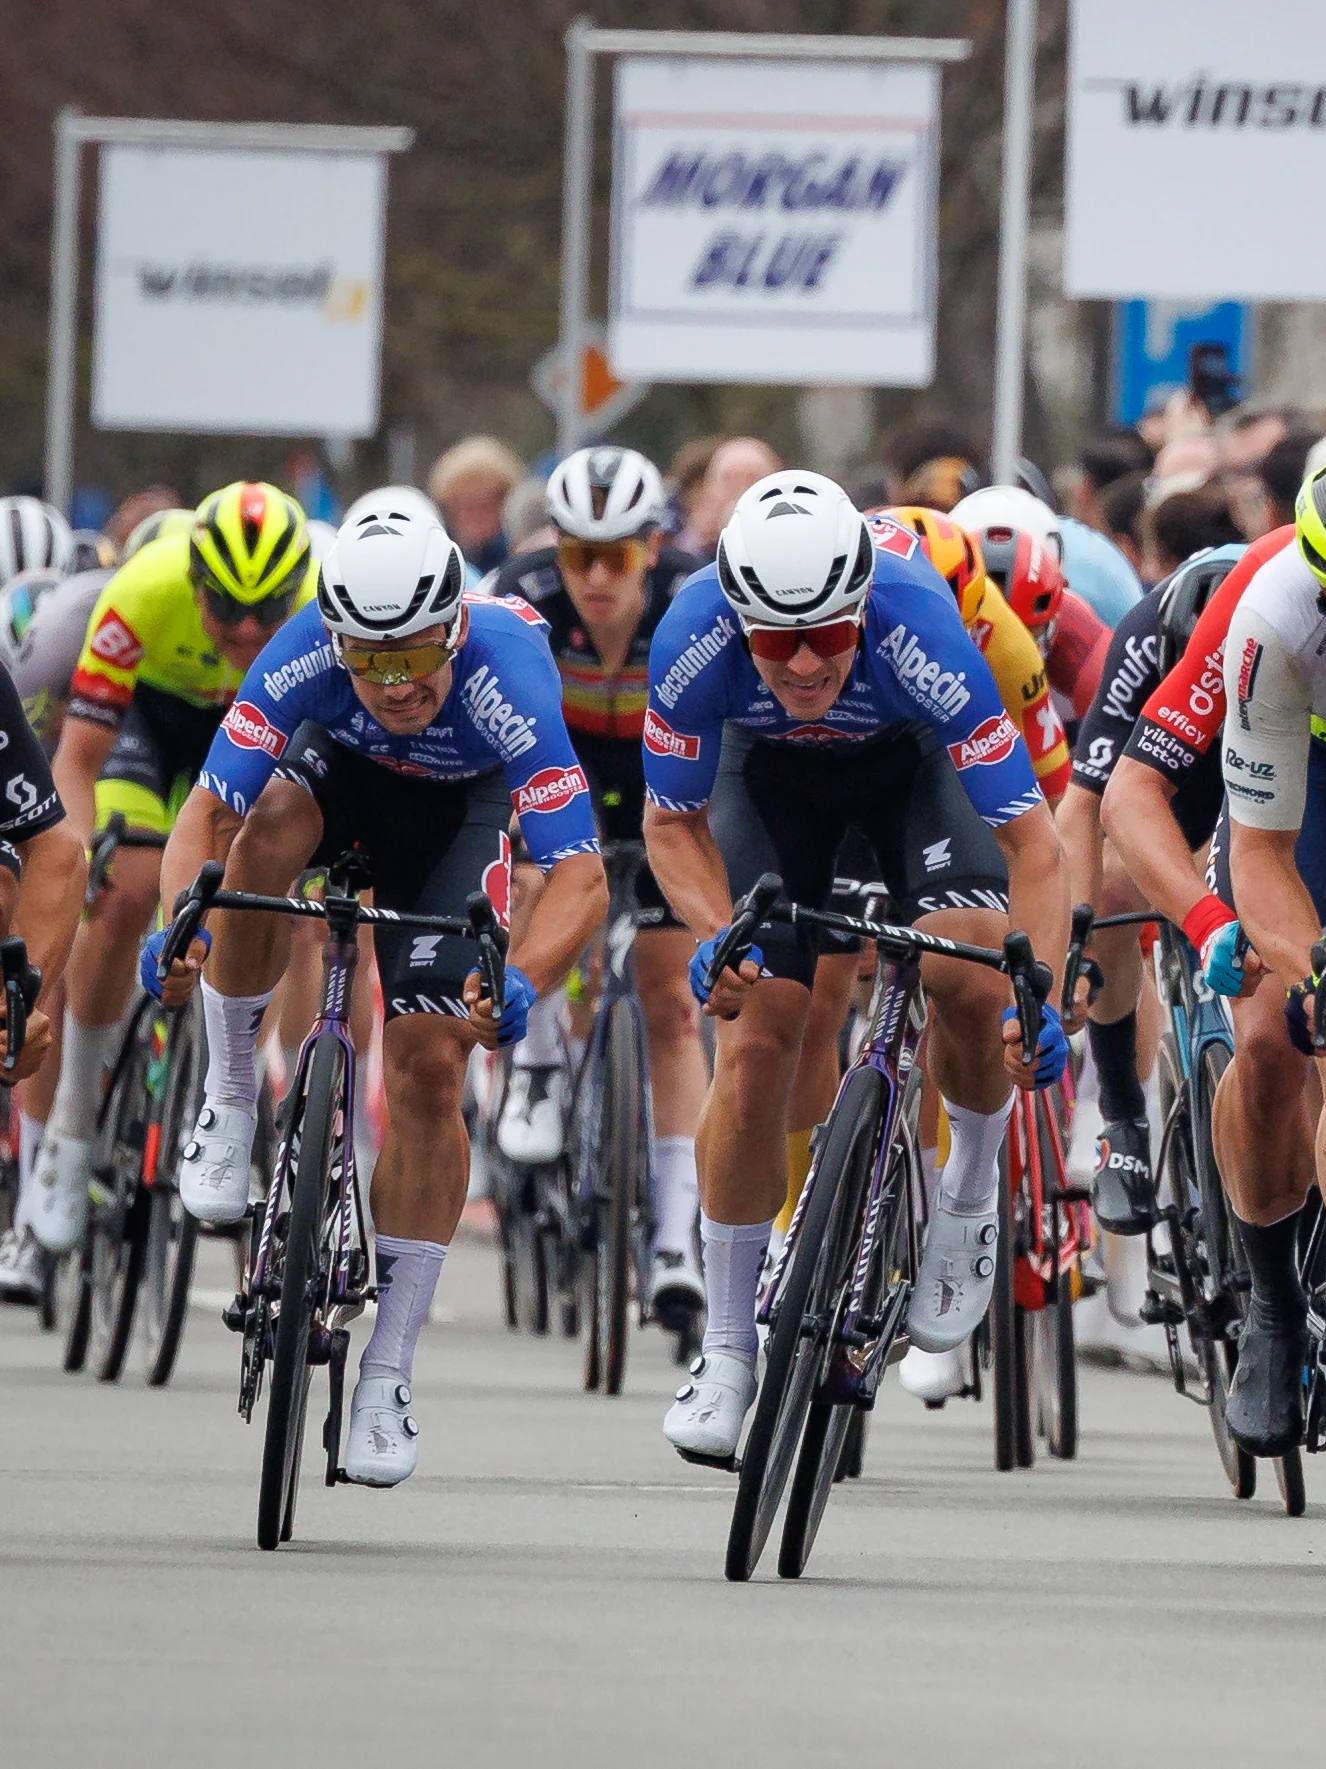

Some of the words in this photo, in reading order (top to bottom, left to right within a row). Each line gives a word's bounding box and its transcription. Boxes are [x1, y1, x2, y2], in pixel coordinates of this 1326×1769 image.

[642, 148, 908, 210] MORGAN
[686, 230, 845, 290] BLUE
[362, 603, 402, 613] CANYON
[774, 586, 815, 597] CANYON
[654, 615, 737, 710] deceuninck
[881, 623, 972, 717] Alpecin
[225, 706, 279, 753] Alpecin
[463, 665, 541, 759] Alpecin
[644, 714, 687, 752] lpecin
[1157, 706, 1207, 745] efficy
[961, 717, 1015, 762] Alpecin
[1136, 737, 1180, 770] lotto
[1143, 725, 1196, 767] viking
[518, 771, 582, 807] Alpecin
[1108, 1152, 1149, 1179] DSM
